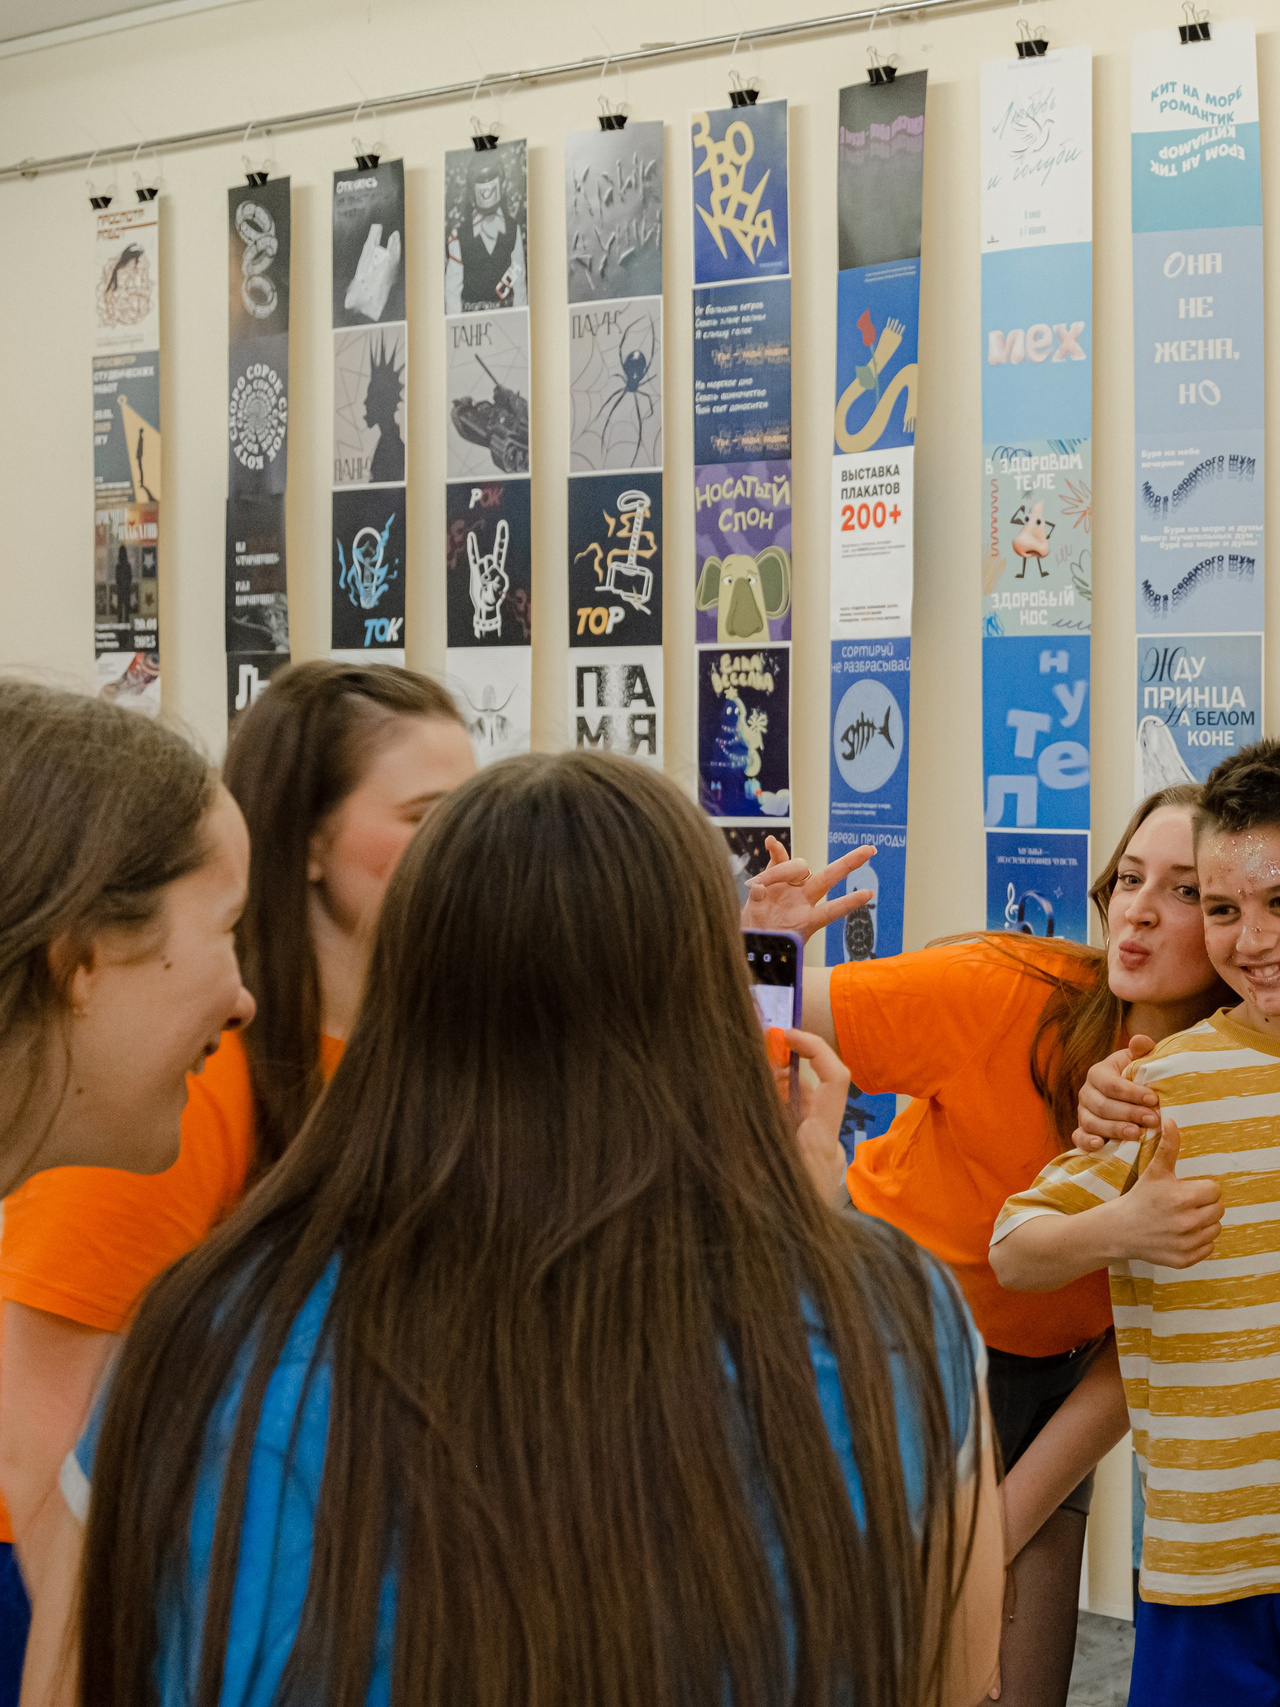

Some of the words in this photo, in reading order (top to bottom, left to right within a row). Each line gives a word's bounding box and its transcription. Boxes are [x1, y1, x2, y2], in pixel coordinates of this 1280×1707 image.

[1151, 81, 1177, 102] КИТ
[1183, 84, 1200, 101] НА
[1205, 85, 1243, 107] МОРЕ
[1160, 99, 1235, 125] РОМАНТИК
[1178, 296, 1213, 319] НЕ
[571, 303, 630, 339] ПАУК
[452, 322, 492, 348] ТАНК
[1154, 337, 1240, 363] ЖЕНА,
[246, 363, 283, 394] СОРОК
[1178, 379, 1221, 406] НО
[841, 464, 900, 482] ВЫСТАВКА
[985, 458, 993, 475] В
[1000, 453, 1083, 474] ЗДОРОВОМ
[695, 475, 790, 510] НОСАТЫЙ
[840, 482, 900, 500] ПЛАКАТОВ
[1014, 474, 1056, 491] ТЕЛЕ
[469, 488, 503, 509] РОК
[718, 508, 774, 533] СЛОН
[841, 501, 901, 532] 200+
[991, 585, 1075, 610] ЗДОРОВЫЙ
[577, 607, 625, 635] ТОР
[1019, 609, 1048, 626] НОС
[364, 618, 403, 647] ТОК
[1143, 686, 1246, 712] ПРИНЦА
[1196, 711, 1255, 726] БЕЛОМ
[1187, 730, 1235, 747] КОНЕ
